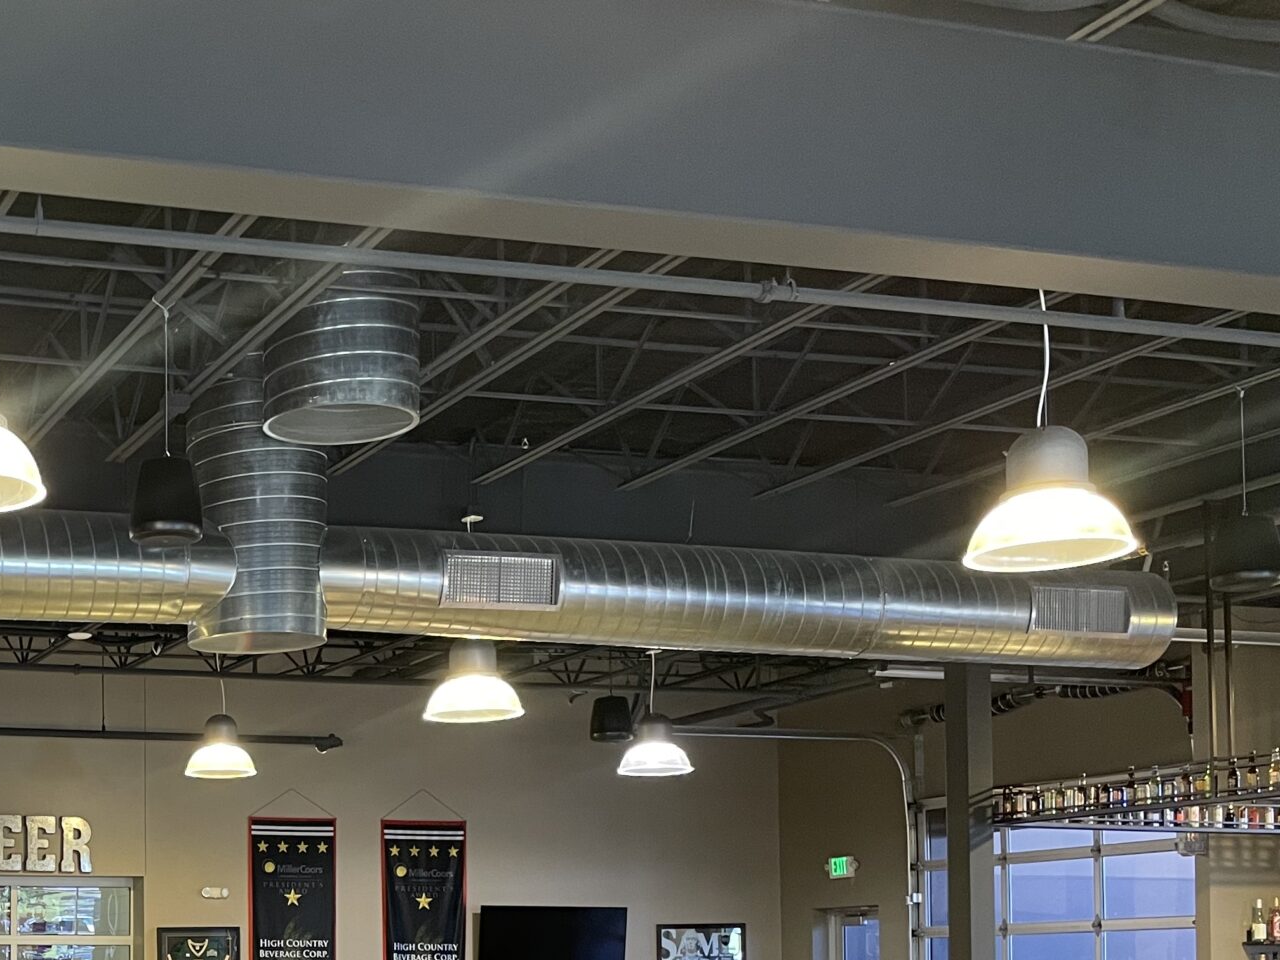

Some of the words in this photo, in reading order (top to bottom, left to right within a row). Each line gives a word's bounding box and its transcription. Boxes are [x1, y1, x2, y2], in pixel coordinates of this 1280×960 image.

[276, 864, 324, 874] MillerCoors
[832, 858, 848, 875] EXIT
[259, 938, 284, 948] HIGH
[285, 938, 329, 948] COUNTRY
[393, 942, 415, 951] HIGH
[417, 942, 458, 952] COUNTRY
[259, 949, 301, 958] BEVERAGE
[302, 949, 329, 958] CORP.
